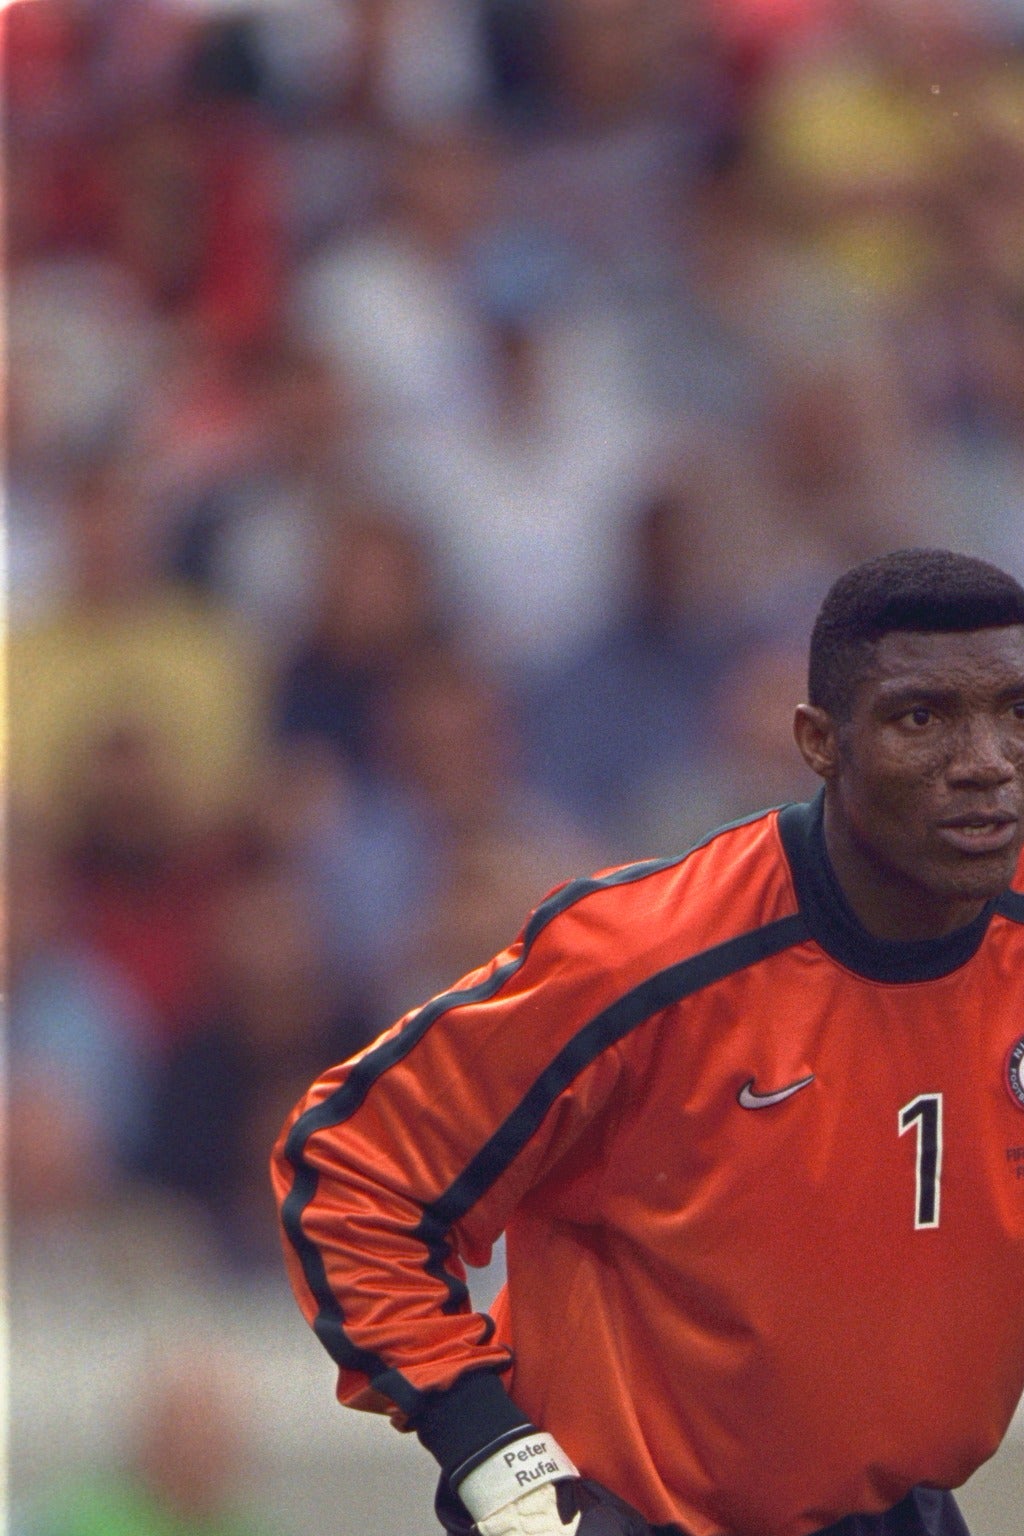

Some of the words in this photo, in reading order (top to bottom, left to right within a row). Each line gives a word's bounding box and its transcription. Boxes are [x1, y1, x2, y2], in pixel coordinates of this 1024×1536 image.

[898, 1092, 943, 1230] 1
[503, 1442, 547, 1469] Peter
[515, 1458, 559, 1487] Rufai
